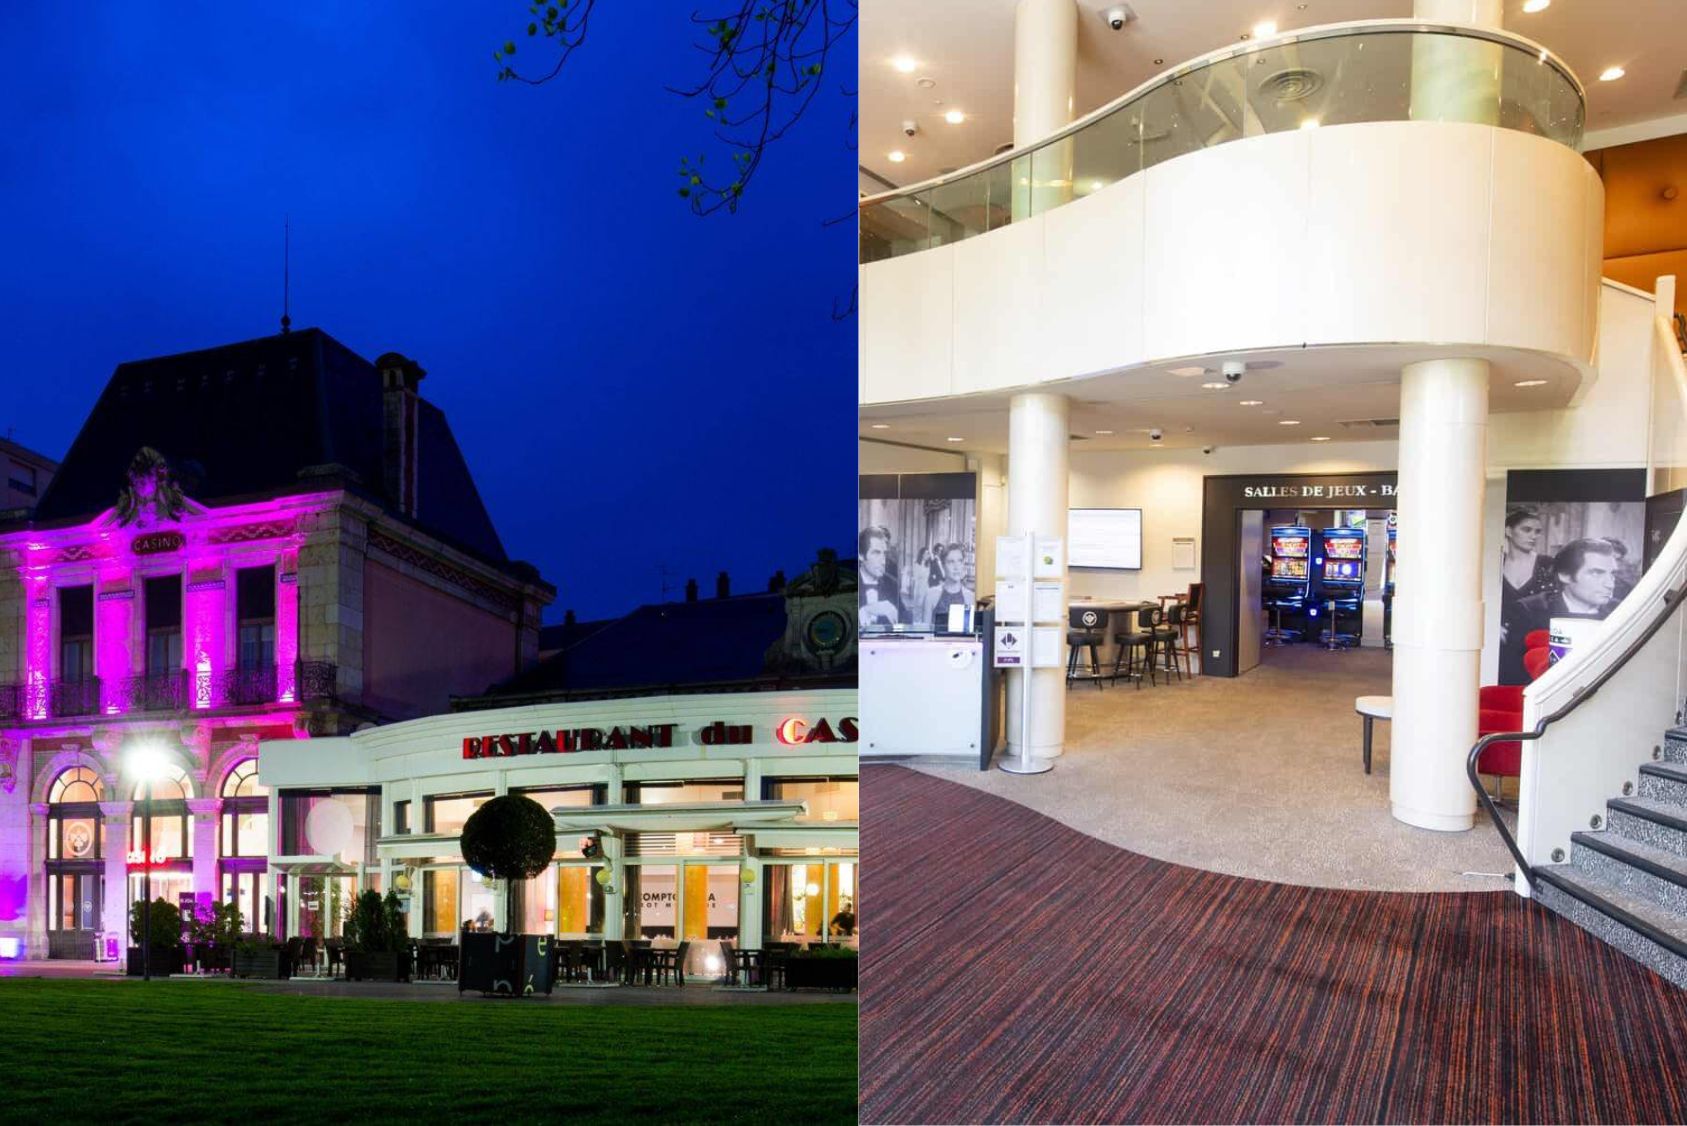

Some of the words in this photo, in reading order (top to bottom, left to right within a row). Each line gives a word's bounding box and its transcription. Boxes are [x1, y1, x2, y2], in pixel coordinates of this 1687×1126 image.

[1244, 486, 1298, 498] SALLES
[1302, 486, 1323, 497] DE
[1326, 485, 1366, 498] JEUX
[134, 535, 181, 551] CASINO
[463, 723, 679, 759] RESTAURANT
[700, 721, 753, 745] du
